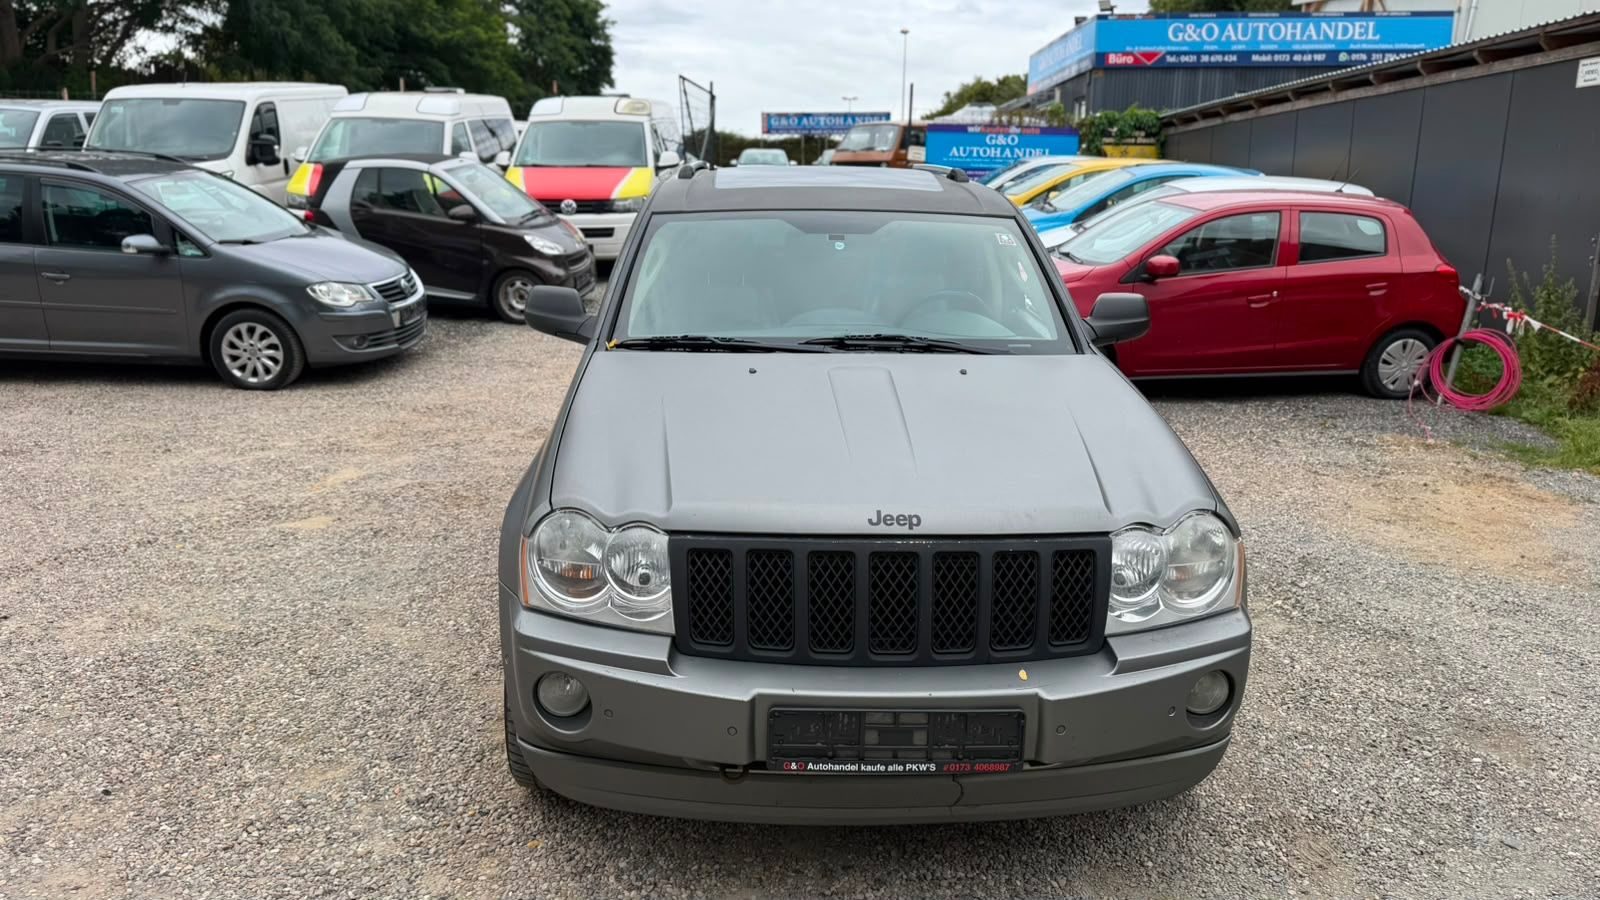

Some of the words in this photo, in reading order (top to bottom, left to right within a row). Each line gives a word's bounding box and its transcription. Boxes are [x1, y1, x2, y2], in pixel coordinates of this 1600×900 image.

[1167, 22, 1219, 41] G&O
[1221, 21, 1380, 41] AUTOHANDEL
[1108, 53, 1134, 64] Büro
[985, 134, 1019, 145] G&O
[867, 510, 922, 530] Jeep
[783, 762, 805, 770] G&O
[807, 762, 859, 771] Autohandel
[860, 762, 886, 771] kaufe
[887, 763, 904, 771] alle
[905, 763, 937, 771] PKW'S
